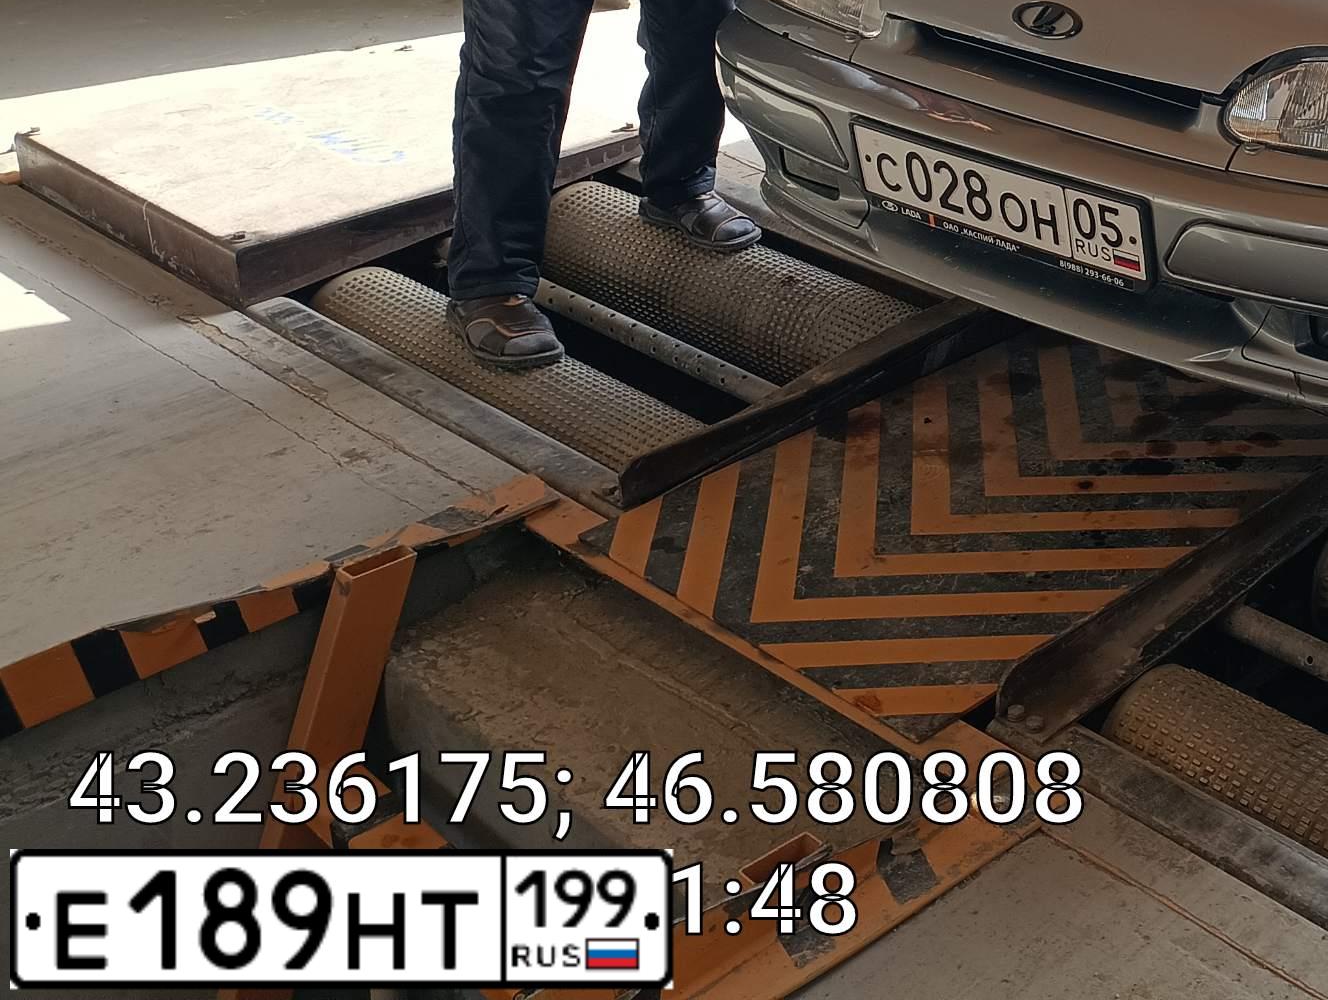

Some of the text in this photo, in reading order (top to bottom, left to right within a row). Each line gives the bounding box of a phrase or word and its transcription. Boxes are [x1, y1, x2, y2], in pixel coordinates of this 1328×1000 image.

[900, 206, 922, 220] LADA
[942, 221, 959, 233] ОАО
[1072, 197, 1124, 248] 05
[1075, 238, 1112, 261] RUS
